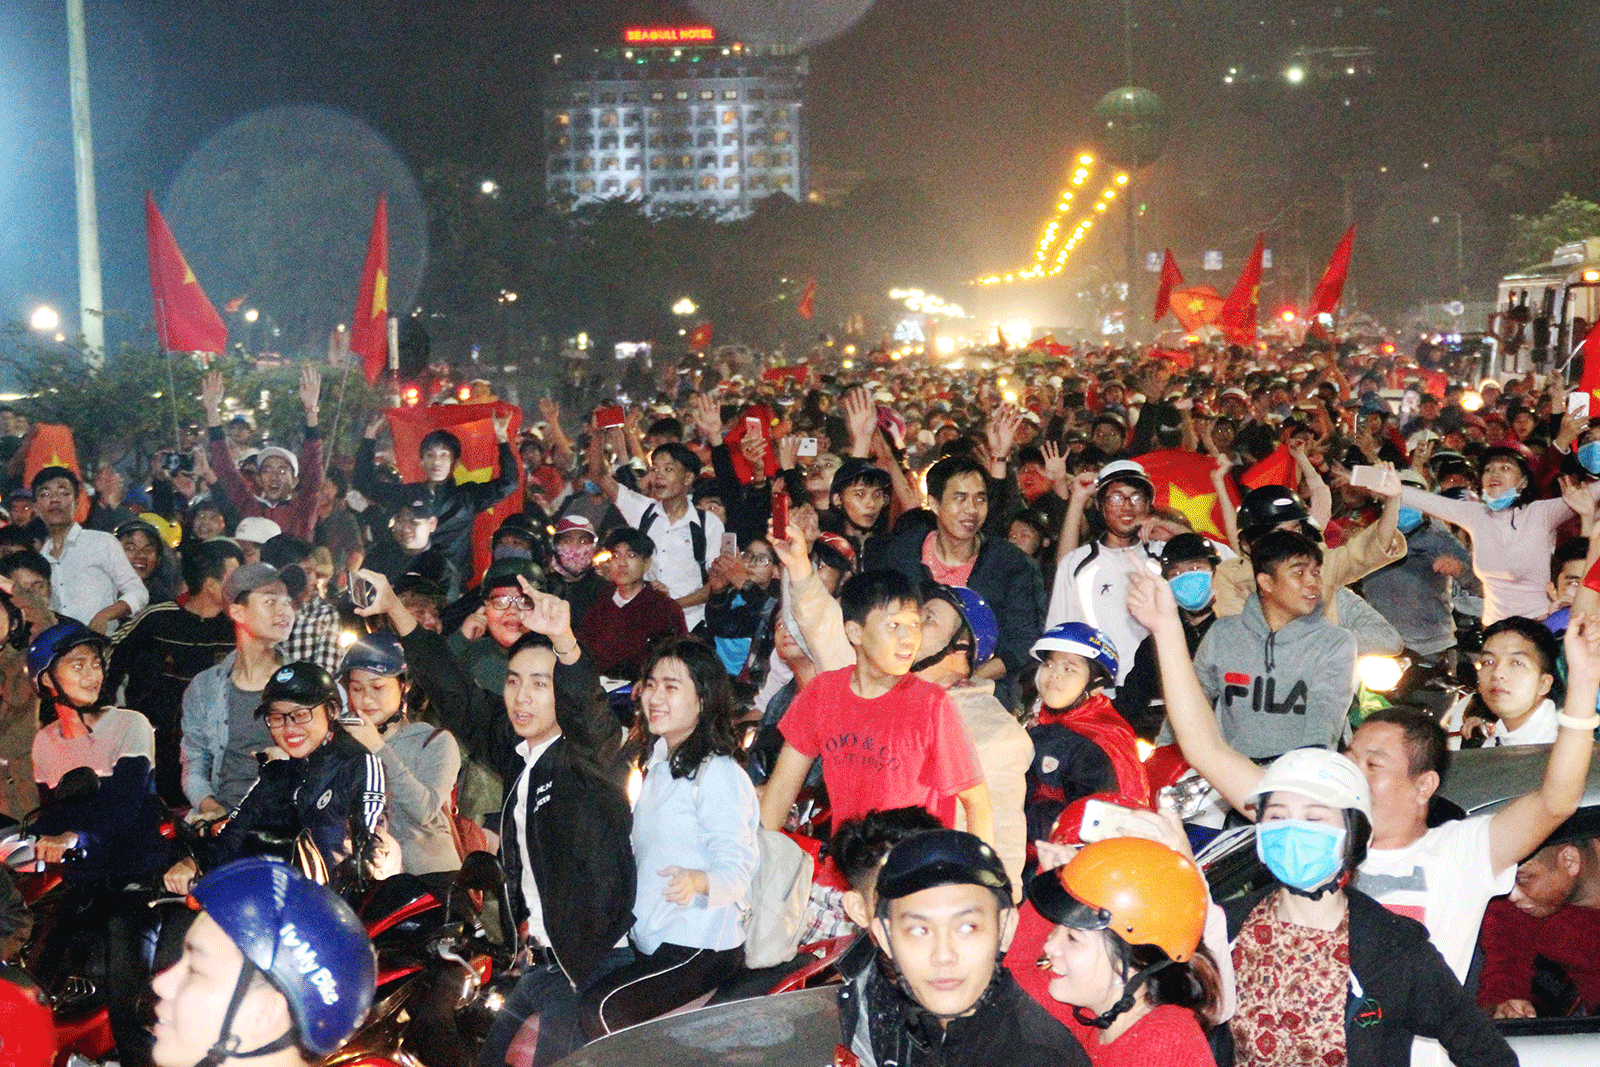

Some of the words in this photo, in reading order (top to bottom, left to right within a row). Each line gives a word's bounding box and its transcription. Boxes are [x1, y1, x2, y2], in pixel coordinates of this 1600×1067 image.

[679, 28, 715, 40] HOTEL
[1224, 672, 1308, 715] FILA
[293, 942, 320, 974] My
